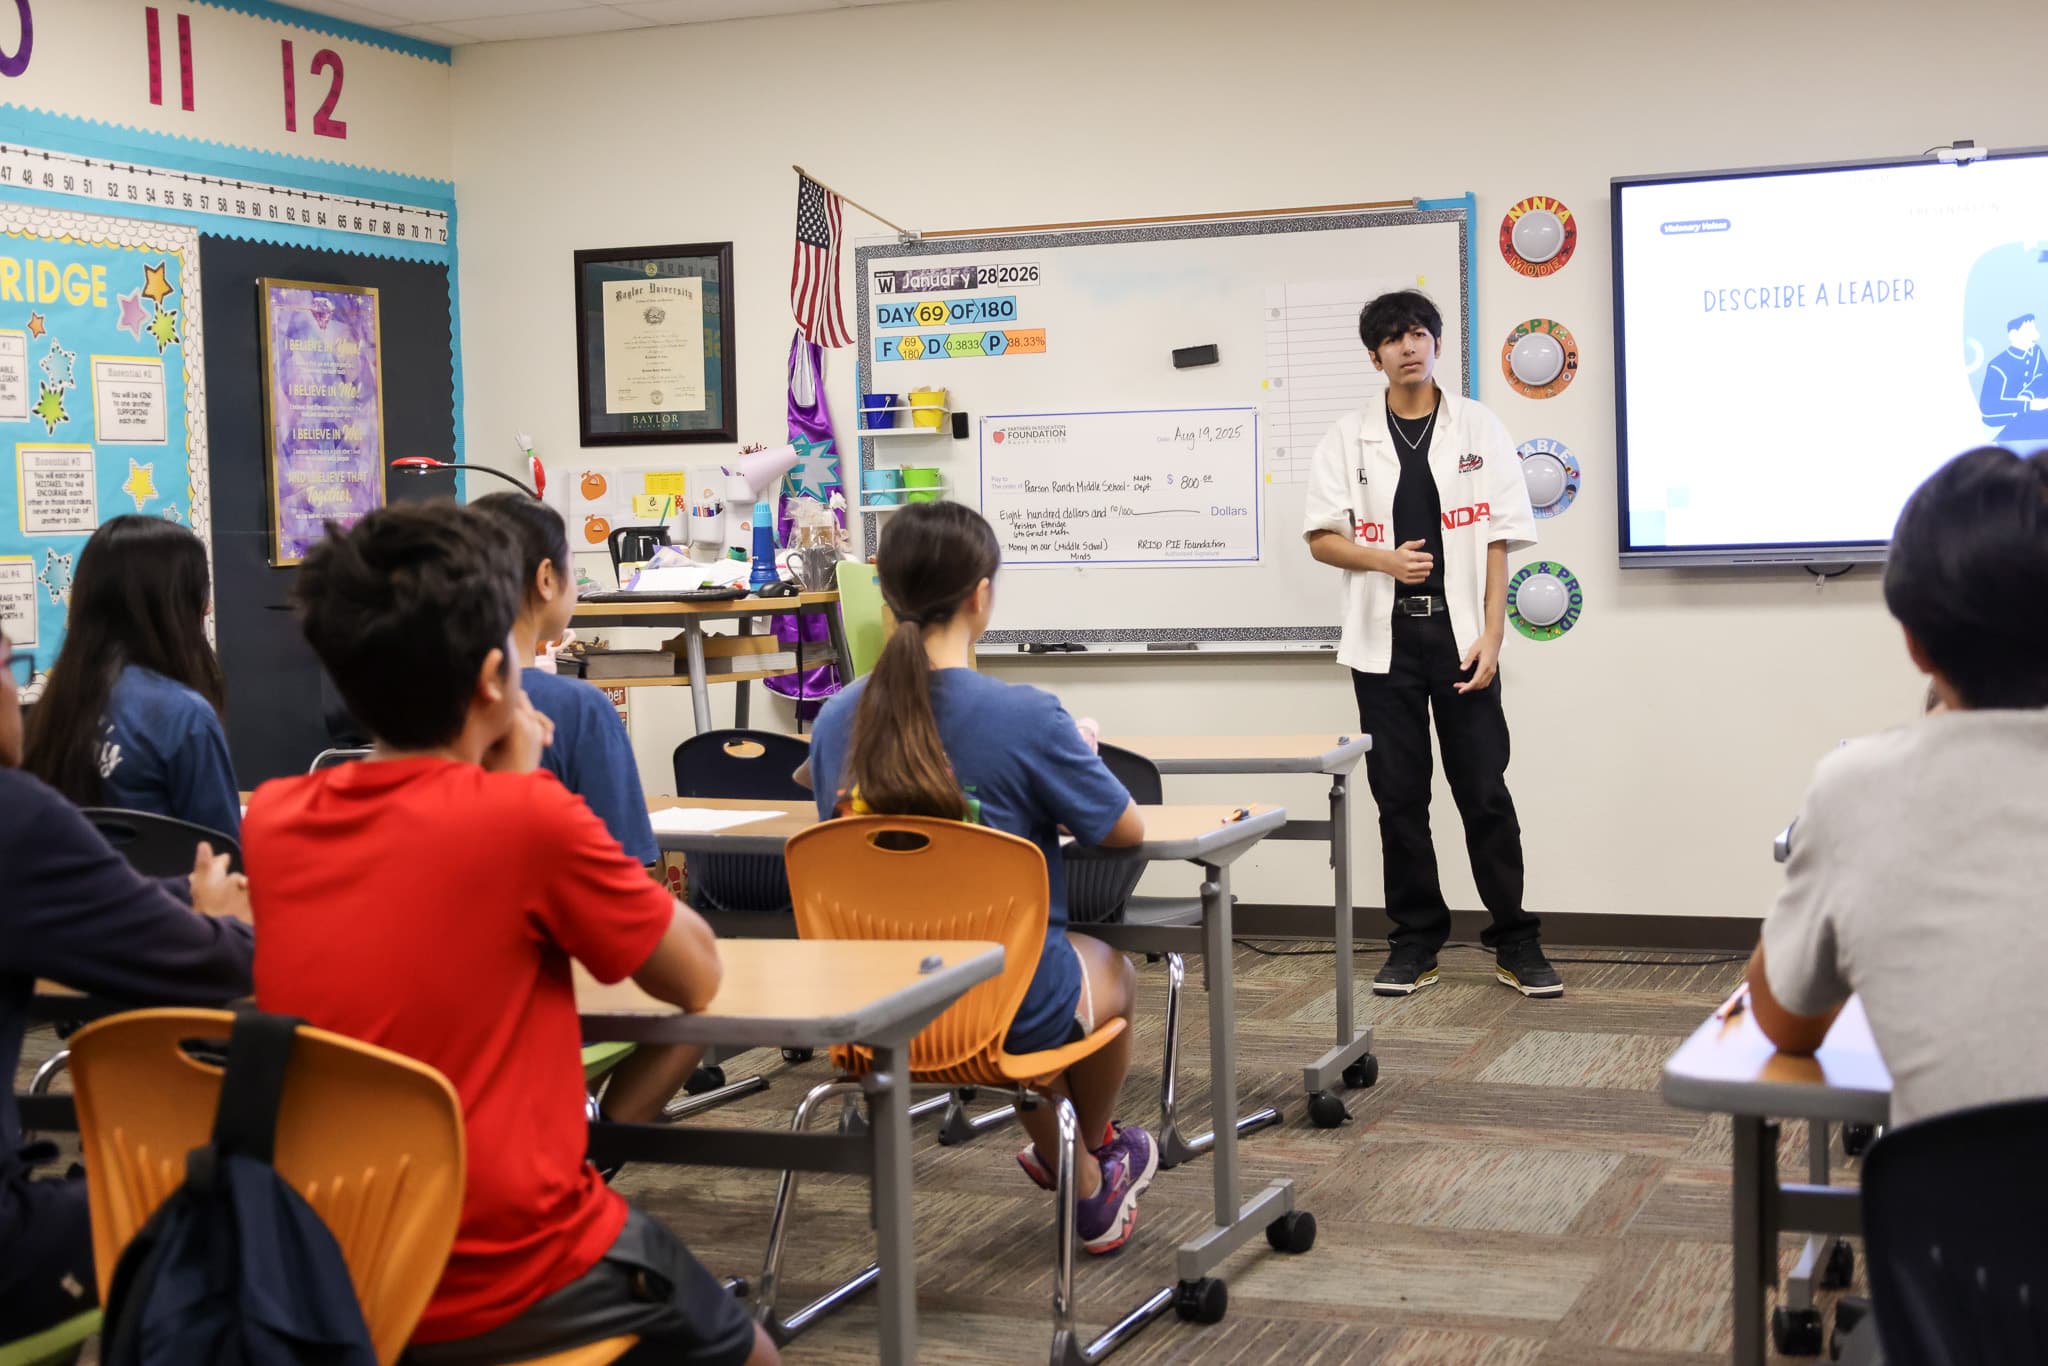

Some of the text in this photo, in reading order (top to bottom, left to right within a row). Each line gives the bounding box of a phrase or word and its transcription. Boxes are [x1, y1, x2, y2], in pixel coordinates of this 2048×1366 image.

[145, 6, 195, 112] 11
[281, 39, 347, 139] 12
[1, 165, 447, 242] 47 48 49 50 51 52 53 54 55 56 57 58 59 60 61 62 63 64 65 66 67 68 69 70 71 72
[1507, 197, 1572, 224] NINJA
[1510, 257, 1562, 277] MODE
[879, 266, 1039, 293] W January 28 2026
[616, 283, 693, 301] Baylor University
[1704, 279, 1915, 313] DESCRIBE A LEADER
[878, 300, 1013, 324] DAY 69 OF 180
[1516, 319, 1559, 336] SPY
[290, 340, 323, 352] BELIEVE
[883, 342, 892, 357] F
[904, 337, 916, 347] 69
[928, 339, 979, 354] D 0.3833
[990, 335, 1045, 351] P 38.33%
[903, 350, 920, 360] 180
[294, 384, 326, 396] BELIEVE
[328, 386, 336, 397] IN
[633, 414, 678, 424] BAYLOR
[298, 428, 331, 440] BELIEVE
[333, 429, 341, 440] IN
[1008, 430, 1066, 439] FOUNDATION
[1174, 427, 1195, 451] Aug
[1215, 425, 1243, 440] 2025
[1523, 439, 1571, 463] ABLE
[288, 471, 305, 483] AND
[347, 471, 368, 483] THAT
[1167, 474, 1174, 485] $
[1181, 475, 1199, 489] 800
[1025, 480, 1049, 493] Pearson
[1052, 481, 1074, 493] Ranch
[1077, 481, 1100, 493] Middle
[1000, 510, 1022, 525] Eight
[1027, 508, 1060, 519] hundred
[1063, 507, 1089, 519] dollars
[1091, 507, 1107, 519] and
[1210, 506, 1247, 516] Dollars
[1041, 521, 1066, 531] Ethridge
[1009, 543, 1027, 554] Money
[1031, 543, 1038, 551] on
[1166, 540, 1180, 549] PIE
[1184, 539, 1226, 549] Foundation
[1538, 562, 1551, 574] &
[1557, 567, 1583, 631] PROUD
